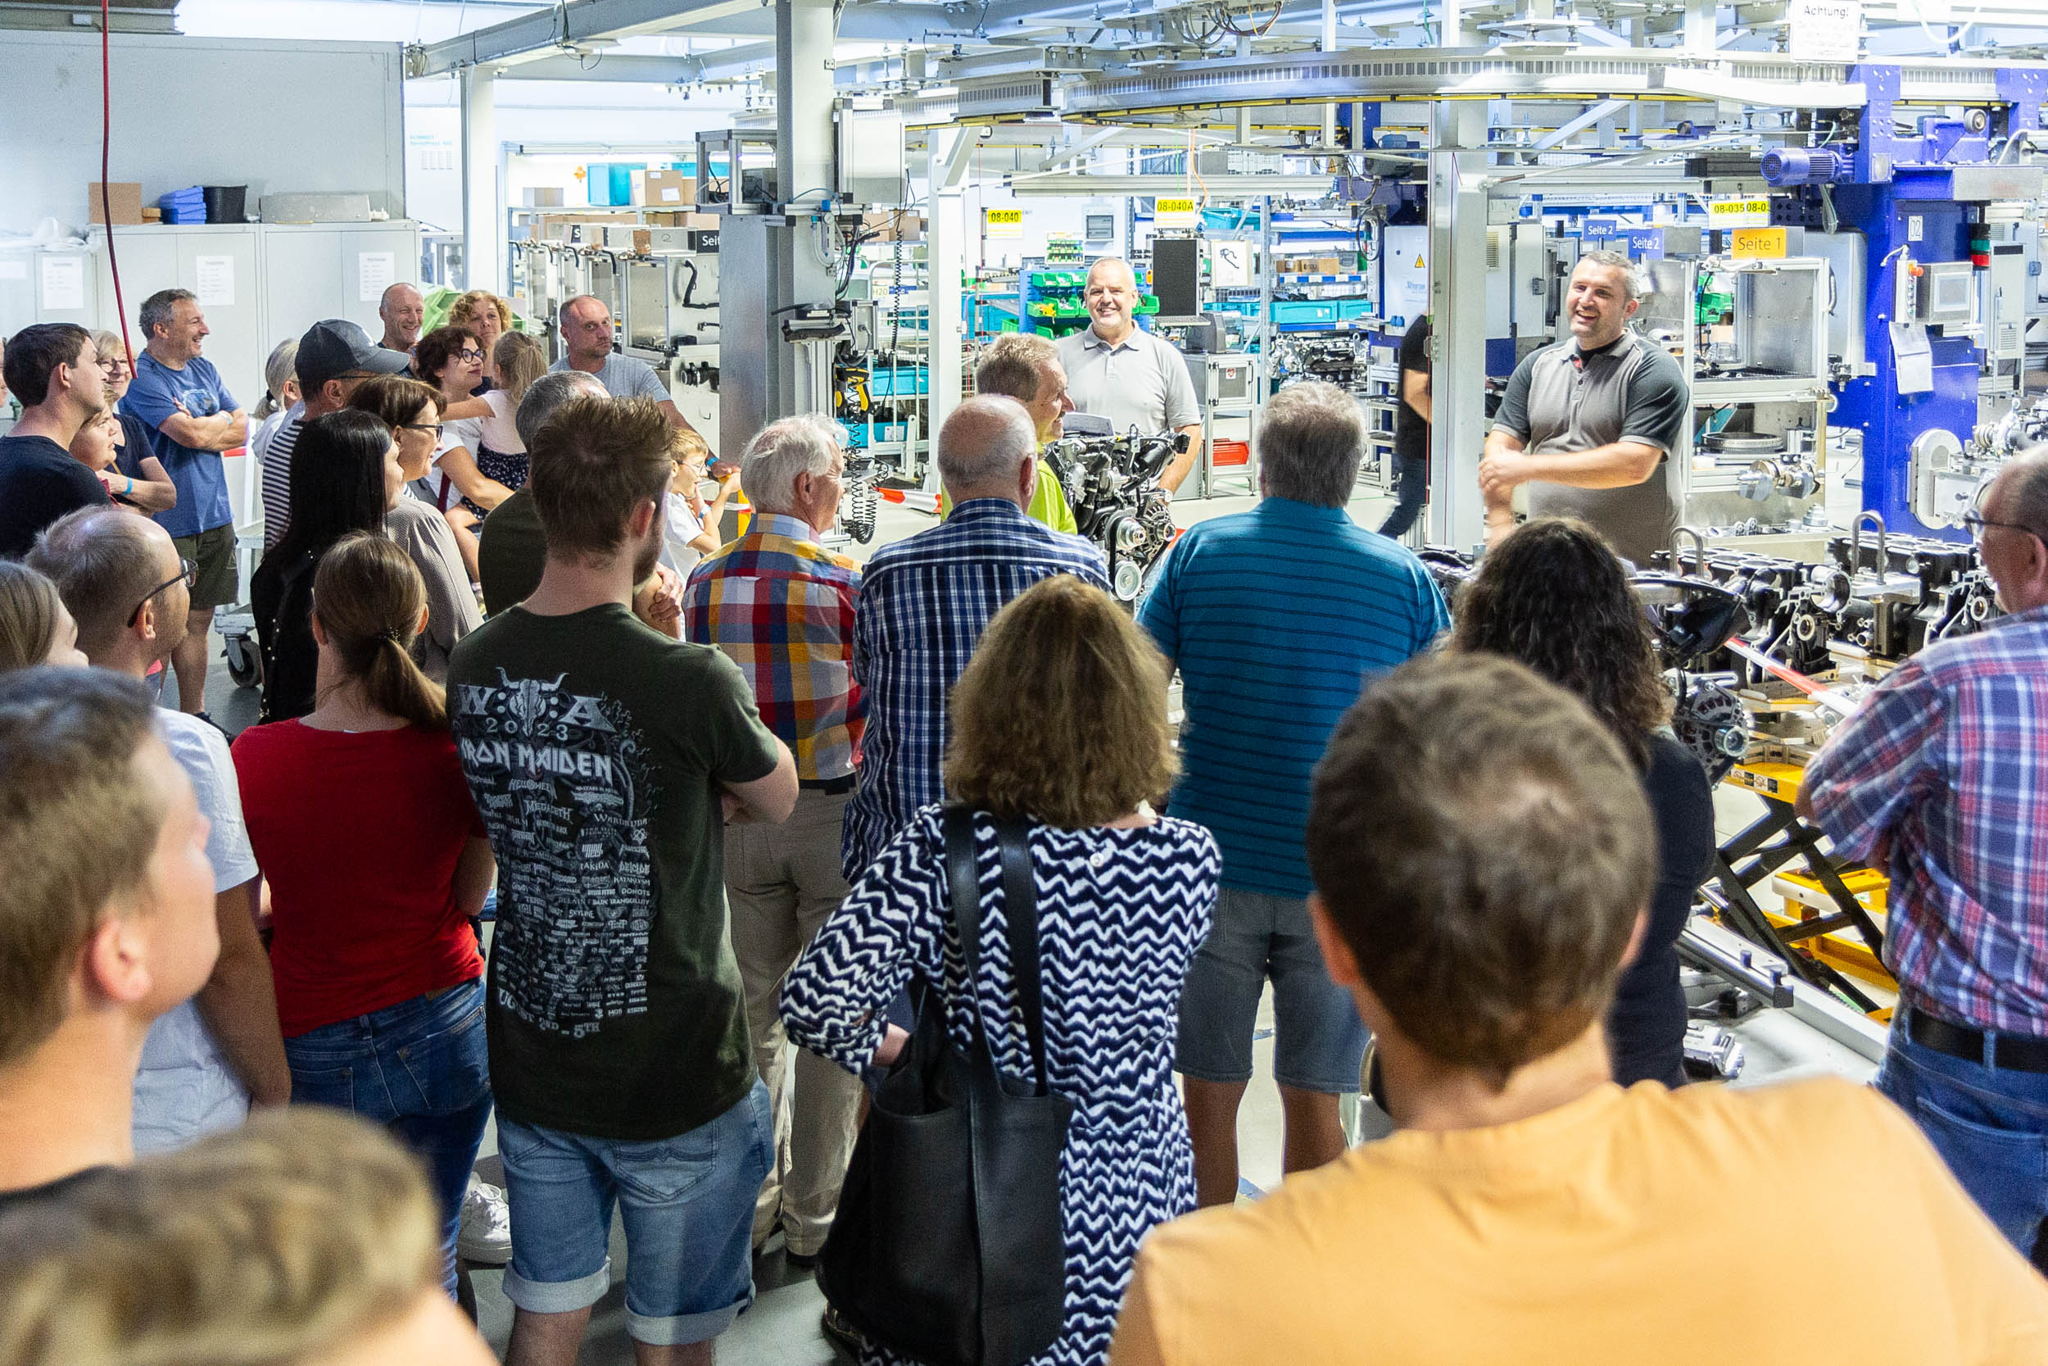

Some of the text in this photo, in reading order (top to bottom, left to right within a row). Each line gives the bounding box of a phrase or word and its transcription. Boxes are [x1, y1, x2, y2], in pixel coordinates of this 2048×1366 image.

[1803, 5, 1849, 20] Achtung!
[1157, 201, 1194, 212] 08-040A
[1714, 204, 1745, 213] 08-035
[1746, 202, 1767, 212] 08-0
[991, 212, 1019, 222] 08-040
[1588, 225, 1613, 235] Seite 2
[702, 234, 719, 247] Seit
[1632, 236, 1660, 250] Seite 2
[1738, 237, 1781, 251] Seite 1
[461, 737, 614, 787] IRON MAIDEN
[572, 1021, 600, 1039] 5TH
